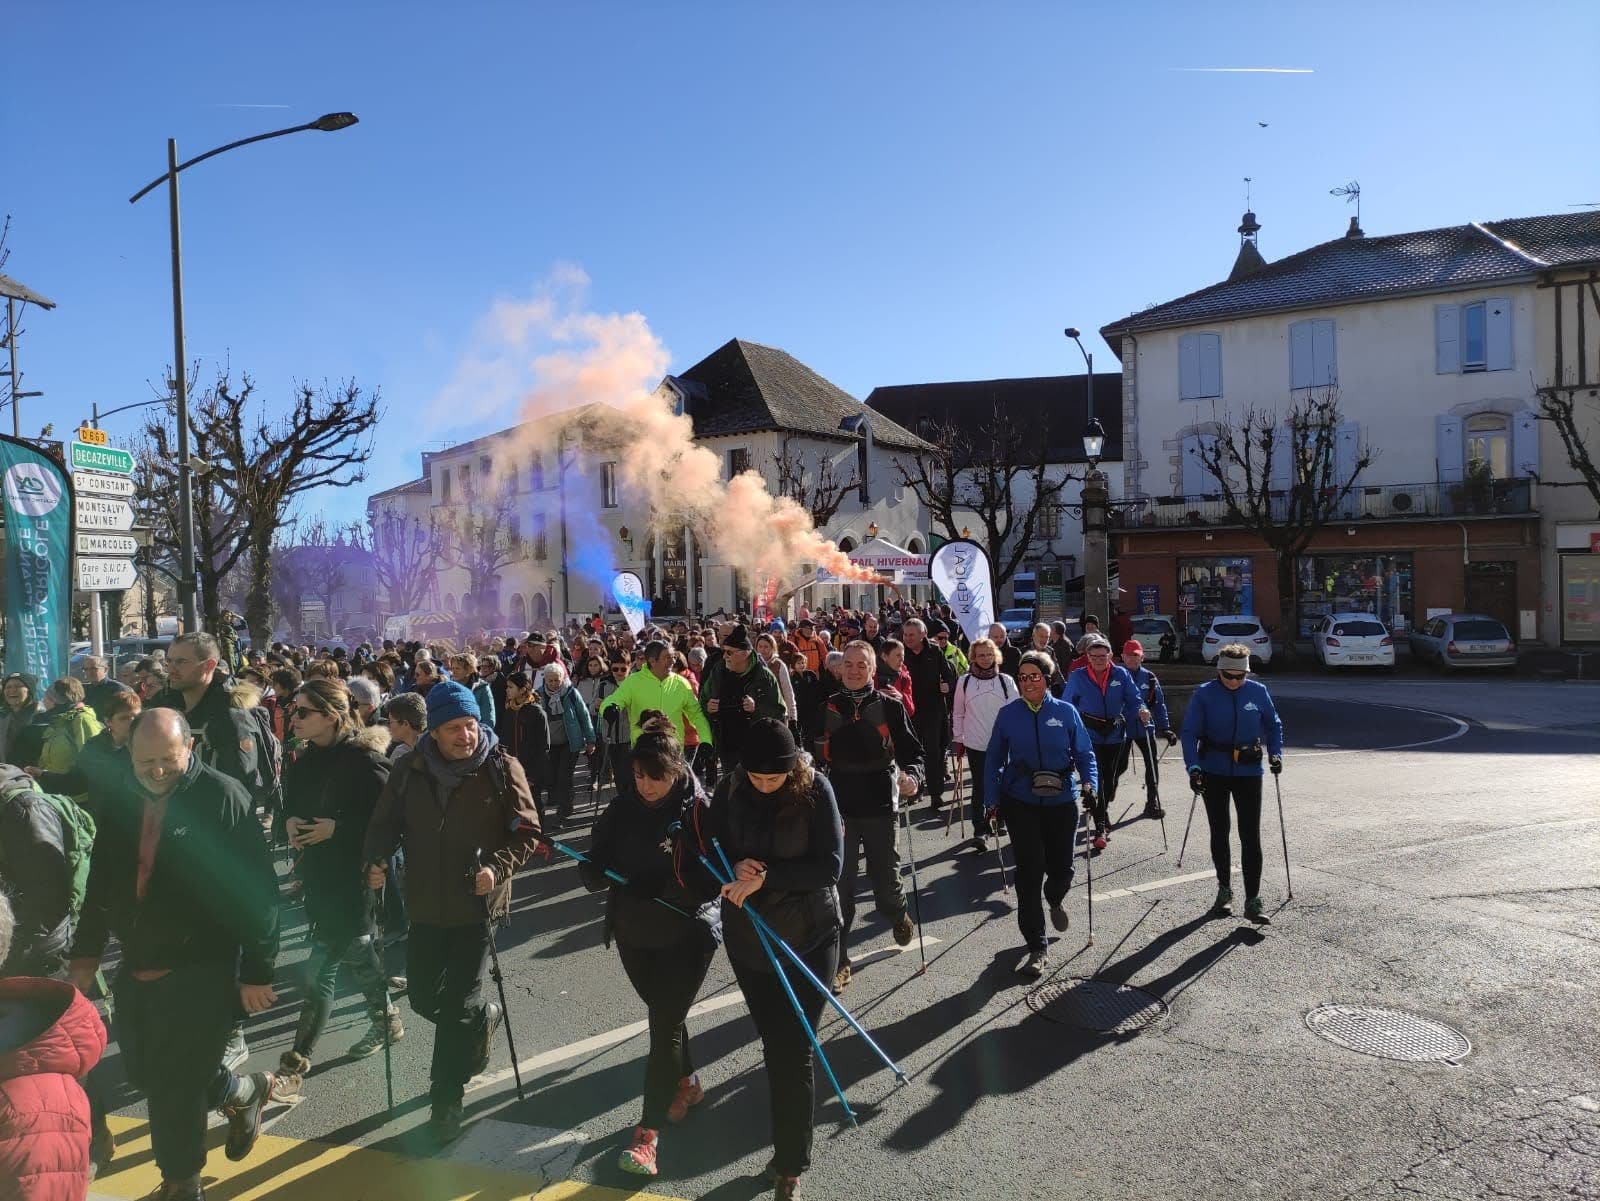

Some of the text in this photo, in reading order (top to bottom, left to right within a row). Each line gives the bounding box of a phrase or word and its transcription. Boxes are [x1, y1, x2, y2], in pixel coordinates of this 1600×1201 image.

[82, 430, 88, 440] D
[75, 449, 128, 468] DECAZEVILLE
[89, 479, 129, 491] CONSTANT
[78, 502, 125, 514] MONTSALVY
[79, 514, 118, 526] CALVINET
[90, 539, 132, 550] MARCOLES
[877, 557, 929, 566] HIVERNAL
[81, 563, 99, 573] Gare
[105, 575, 120, 585] Vert
